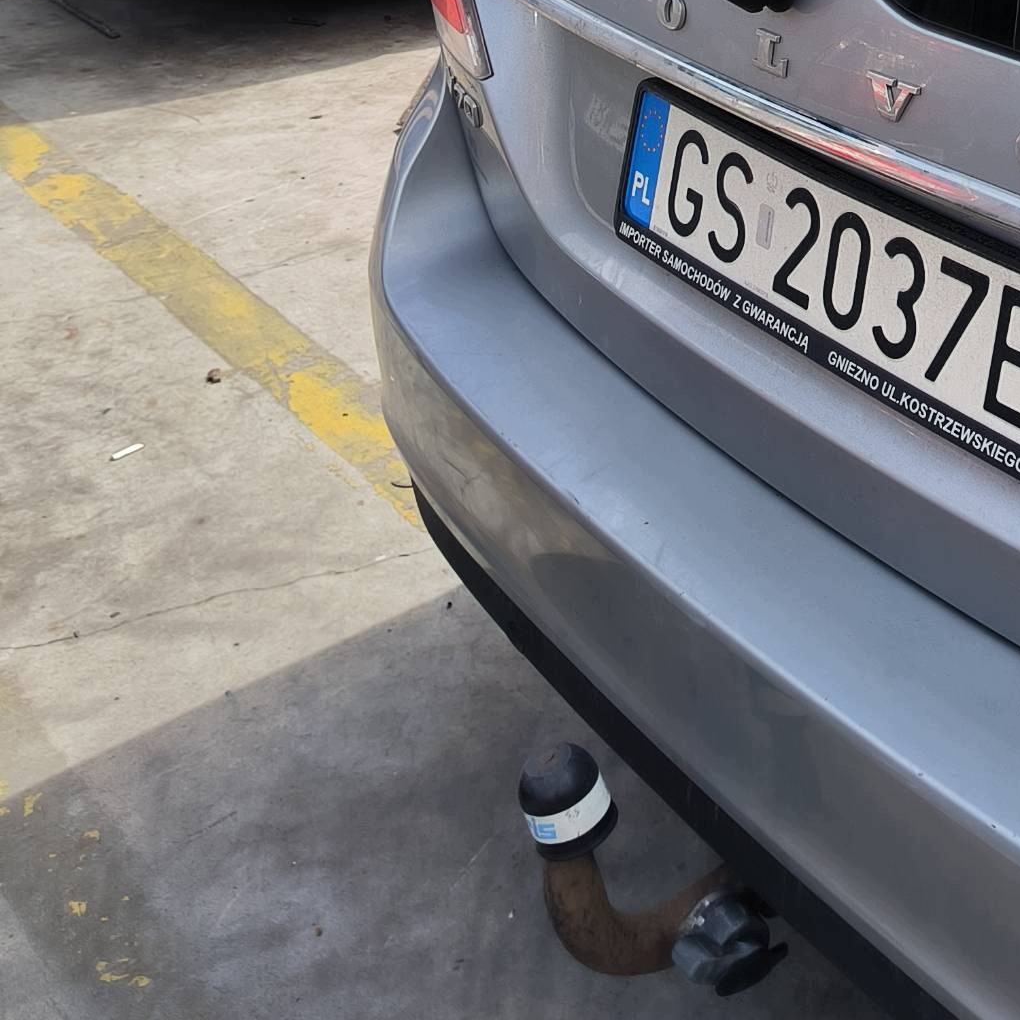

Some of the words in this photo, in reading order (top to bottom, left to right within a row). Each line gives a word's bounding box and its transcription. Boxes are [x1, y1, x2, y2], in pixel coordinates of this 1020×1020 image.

[631, 170, 653, 207] PL
[667, 129, 754, 264] GS
[618, 220, 662, 260] IMPORTER
[661, 249, 732, 301] SAMOCHODÓW
[732, 293, 741, 310] Z
[741, 299, 811, 355] GWARANCJĄ
[827, 350, 880, 392] GNIEZNO
